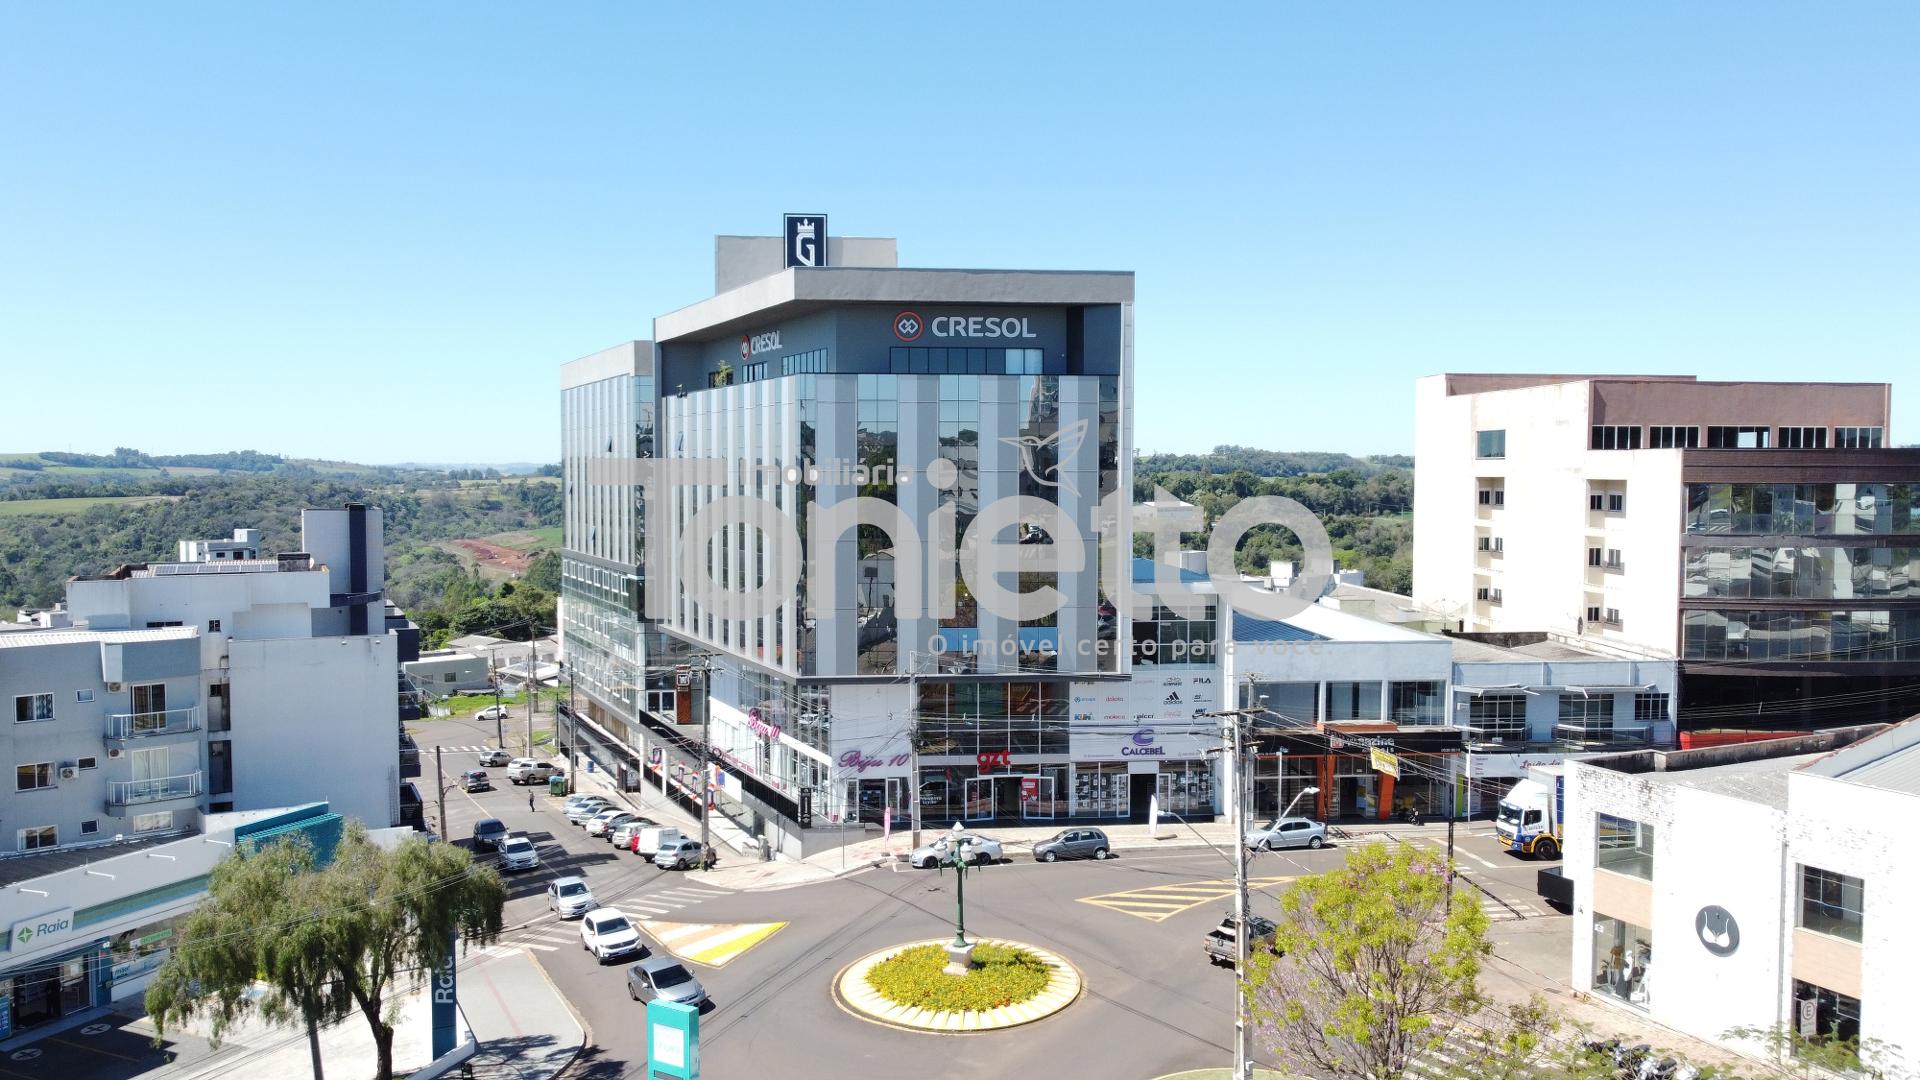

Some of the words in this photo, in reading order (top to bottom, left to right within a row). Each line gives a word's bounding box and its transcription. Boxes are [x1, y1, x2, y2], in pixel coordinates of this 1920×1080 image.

[796, 233, 816, 267] G
[931, 316, 1037, 338] CRESOL
[750, 330, 783, 355] CRESOL
[838, 750, 883, 774] Biju
[889, 752, 910, 768] 10
[977, 748, 1012, 773] gzt
[1121, 745, 1166, 757] CALCEBEL
[36, 918, 69, 937] Raia
[1806, 1005, 1812, 1017] E
